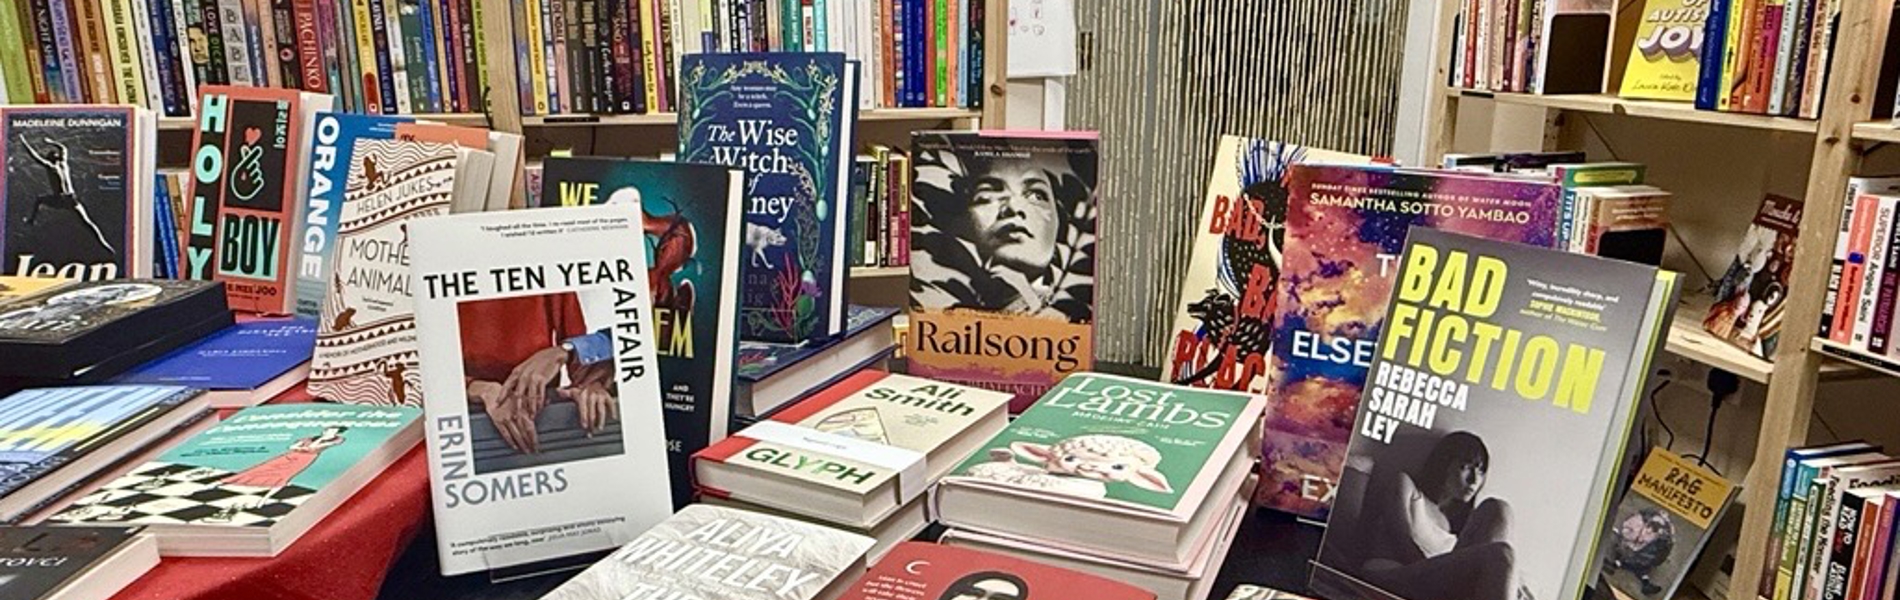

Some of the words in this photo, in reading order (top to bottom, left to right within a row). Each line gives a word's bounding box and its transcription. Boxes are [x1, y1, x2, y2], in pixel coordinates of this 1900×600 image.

[204, 4, 218, 34] LOVE
[1646, 8, 1707, 23] AUTIS
[209, 34, 223, 66] DICK
[298, 10, 322, 90] PACHINKO
[12, 119, 65, 128] MADELEINE
[67, 118, 122, 128] DUNNIGAN
[707, 124, 736, 143] The
[737, 119, 799, 146] Wise
[712, 146, 790, 174] Witch
[186, 94, 229, 281] HOLY
[301, 115, 340, 280] ORANGE
[356, 188, 393, 215] HELEN
[395, 175, 434, 202] JUKES
[559, 181, 601, 207] WE
[748, 173, 764, 195] f
[1311, 182, 1343, 192] SUNDAY
[1344, 185, 1368, 194] TIMES
[1368, 188, 1420, 198] BESTSELLING
[1421, 191, 1456, 202] AUTHOR
[1457, 195, 1469, 203] OF
[1472, 195, 1501, 205] WATER
[1502, 198, 1532, 209] MOON
[748, 195, 796, 223] ney
[1209, 194, 1266, 250] BAD,
[1309, 192, 1398, 213] SAMANTHA
[1400, 200, 1455, 217] SOTTO
[1457, 205, 1531, 225] YAMBAO
[1562, 193, 1574, 220] TITS
[221, 214, 281, 278] BOY
[1560, 220, 1571, 241] UP
[1870, 205, 1891, 261] SUPERIOR
[15, 254, 118, 280] Jean
[423, 270, 479, 300] THE
[489, 265, 546, 292] TEN
[556, 258, 635, 287] YEAR
[1375, 253, 1402, 278] T
[1398, 243, 1509, 320] BAD
[1861, 260, 1880, 296] Angela
[1882, 270, 1898, 287] THE
[1604, 295, 1620, 304] and
[1857, 296, 1873, 323] Saini
[1871, 285, 1894, 335] PATRIARCHS
[611, 286, 646, 383] AFFAIR
[916, 320, 1082, 373] Railsong
[1291, 329, 1379, 368] ELSE
[1380, 303, 1607, 415] FICTION
[672, 384, 690, 393] AND
[864, 386, 975, 417] Smith
[909, 382, 963, 399] Ali
[1070, 376, 1177, 407] Lost
[1374, 360, 1471, 413] REBECCA
[356, 408, 404, 419] the
[664, 402, 696, 412] HUNGRY
[1043, 386, 1231, 429] Lambs
[1071, 410, 1133, 425] MADELINE
[1368, 385, 1438, 432] SARAH
[1360, 417, 1400, 445] LEY
[437, 414, 469, 482] ERIN
[745, 447, 876, 486] GLYPH
[1664, 466, 1703, 496] RAG
[444, 468, 569, 510] SOMERS
[1637, 472, 1714, 520] MANIFESTO
[1820, 474, 1841, 517] Feeding
[687, 516, 806, 559] ALIYA
[1817, 516, 1832, 536] the
[615, 535, 820, 600] WHITELEY
[1810, 534, 1828, 573] Monster
